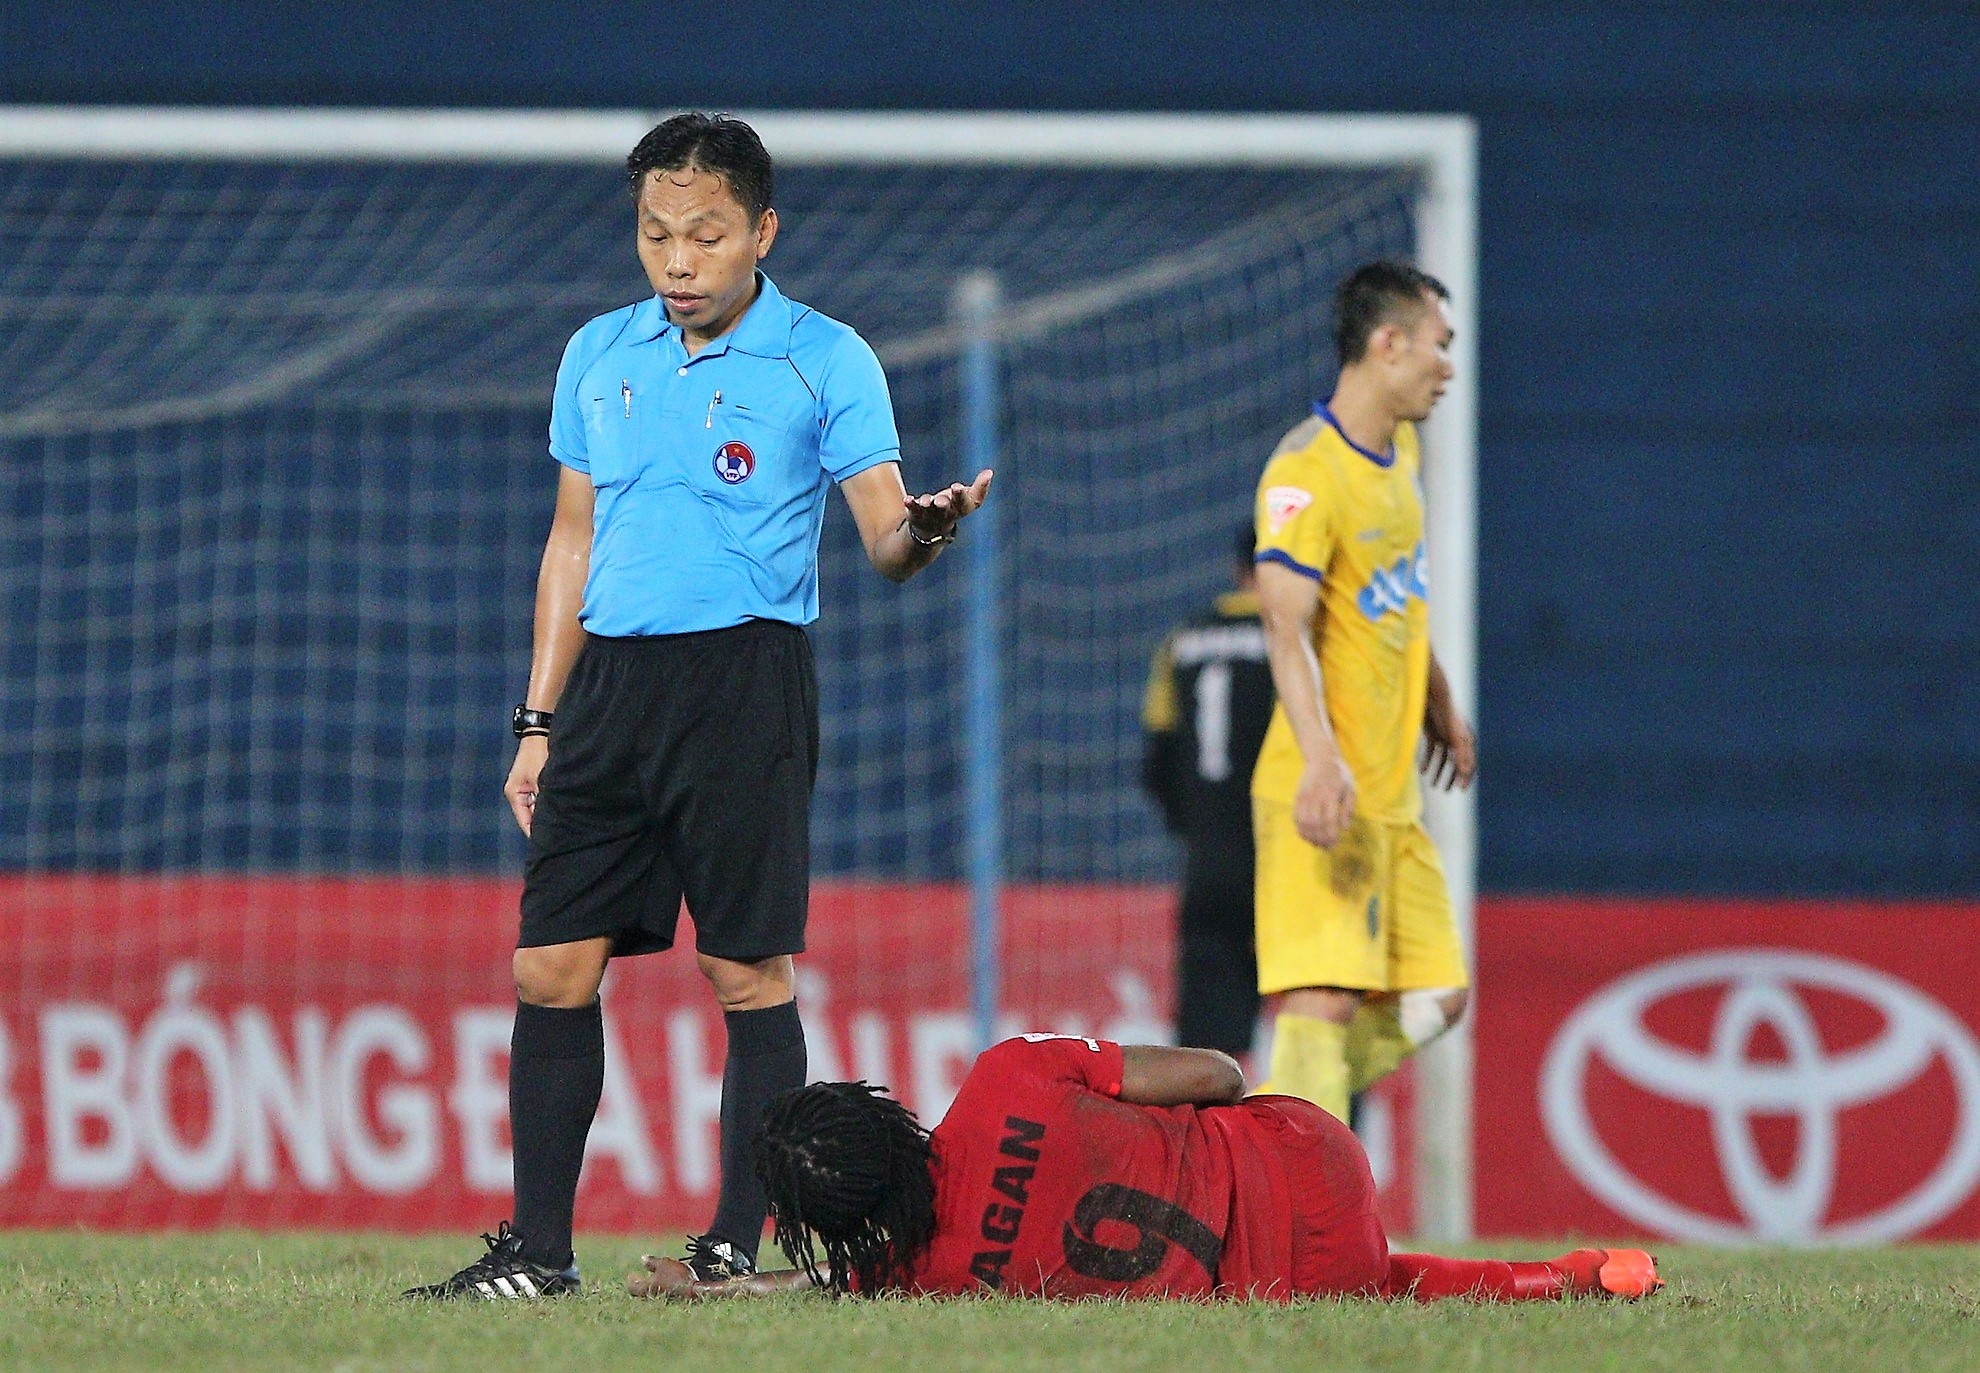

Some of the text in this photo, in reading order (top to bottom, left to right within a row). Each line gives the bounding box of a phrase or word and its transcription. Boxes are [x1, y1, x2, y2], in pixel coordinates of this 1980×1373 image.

[1196, 661, 1232, 782] 1
[38, 960, 439, 1194] BÓNG
[1062, 1182, 1224, 1285] 9
